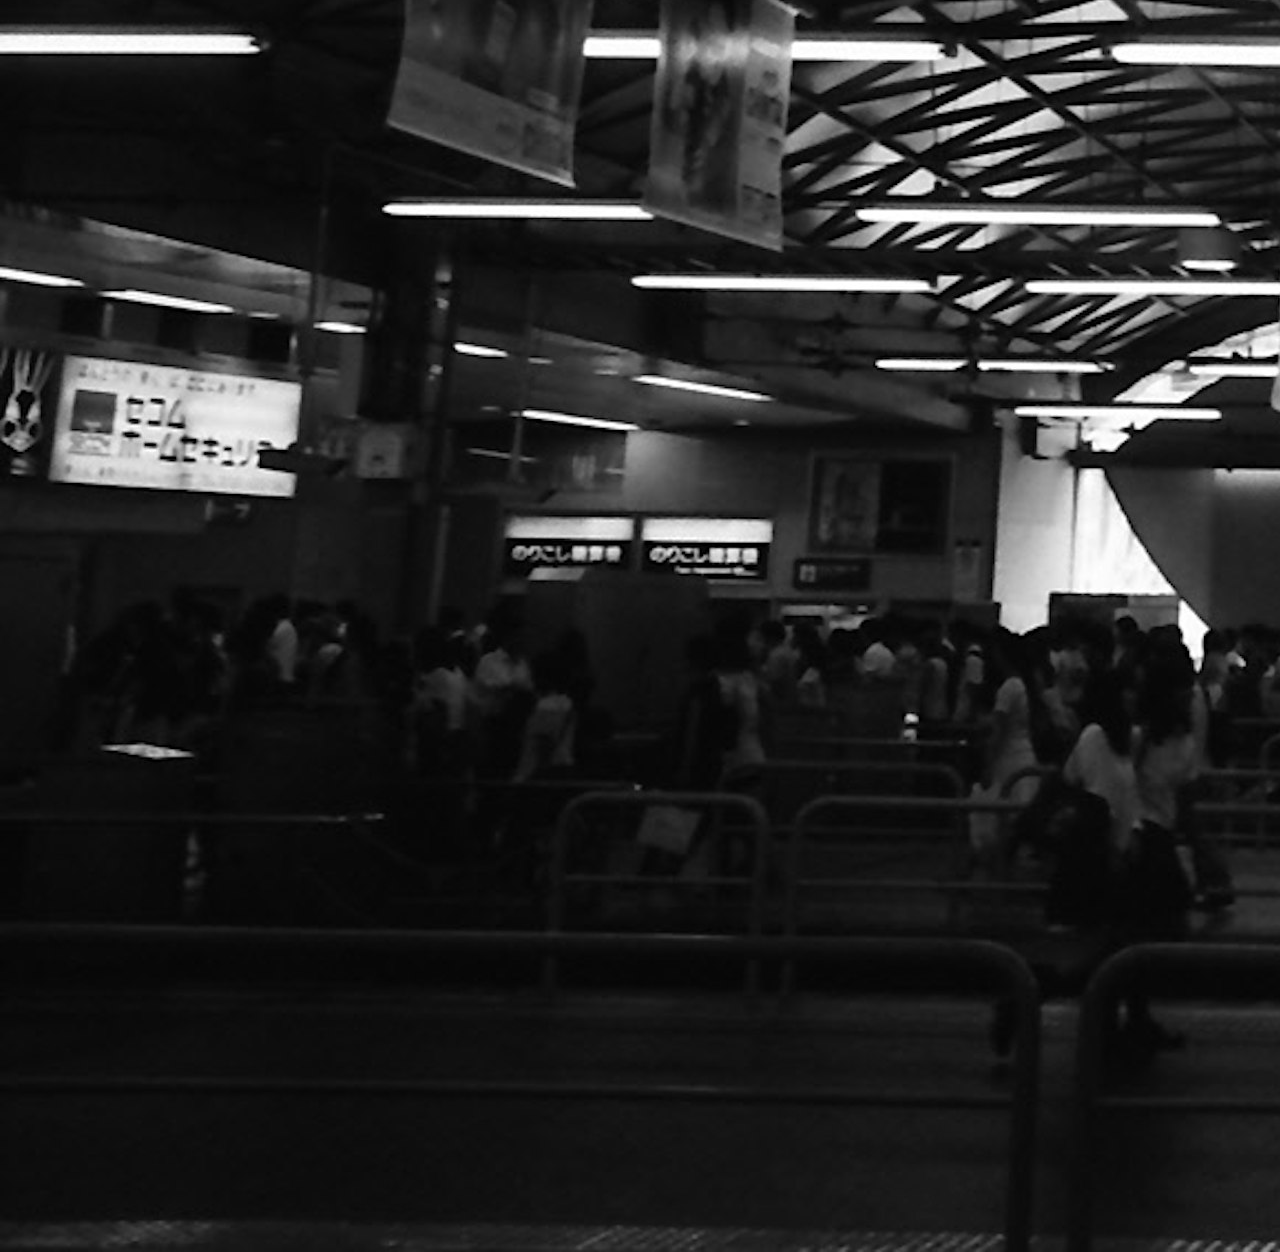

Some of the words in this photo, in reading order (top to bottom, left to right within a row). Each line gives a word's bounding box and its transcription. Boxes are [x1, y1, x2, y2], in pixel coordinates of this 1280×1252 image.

[127, 398, 186, 428] セコム
[120, 431, 272, 467] ホームセキュリ
